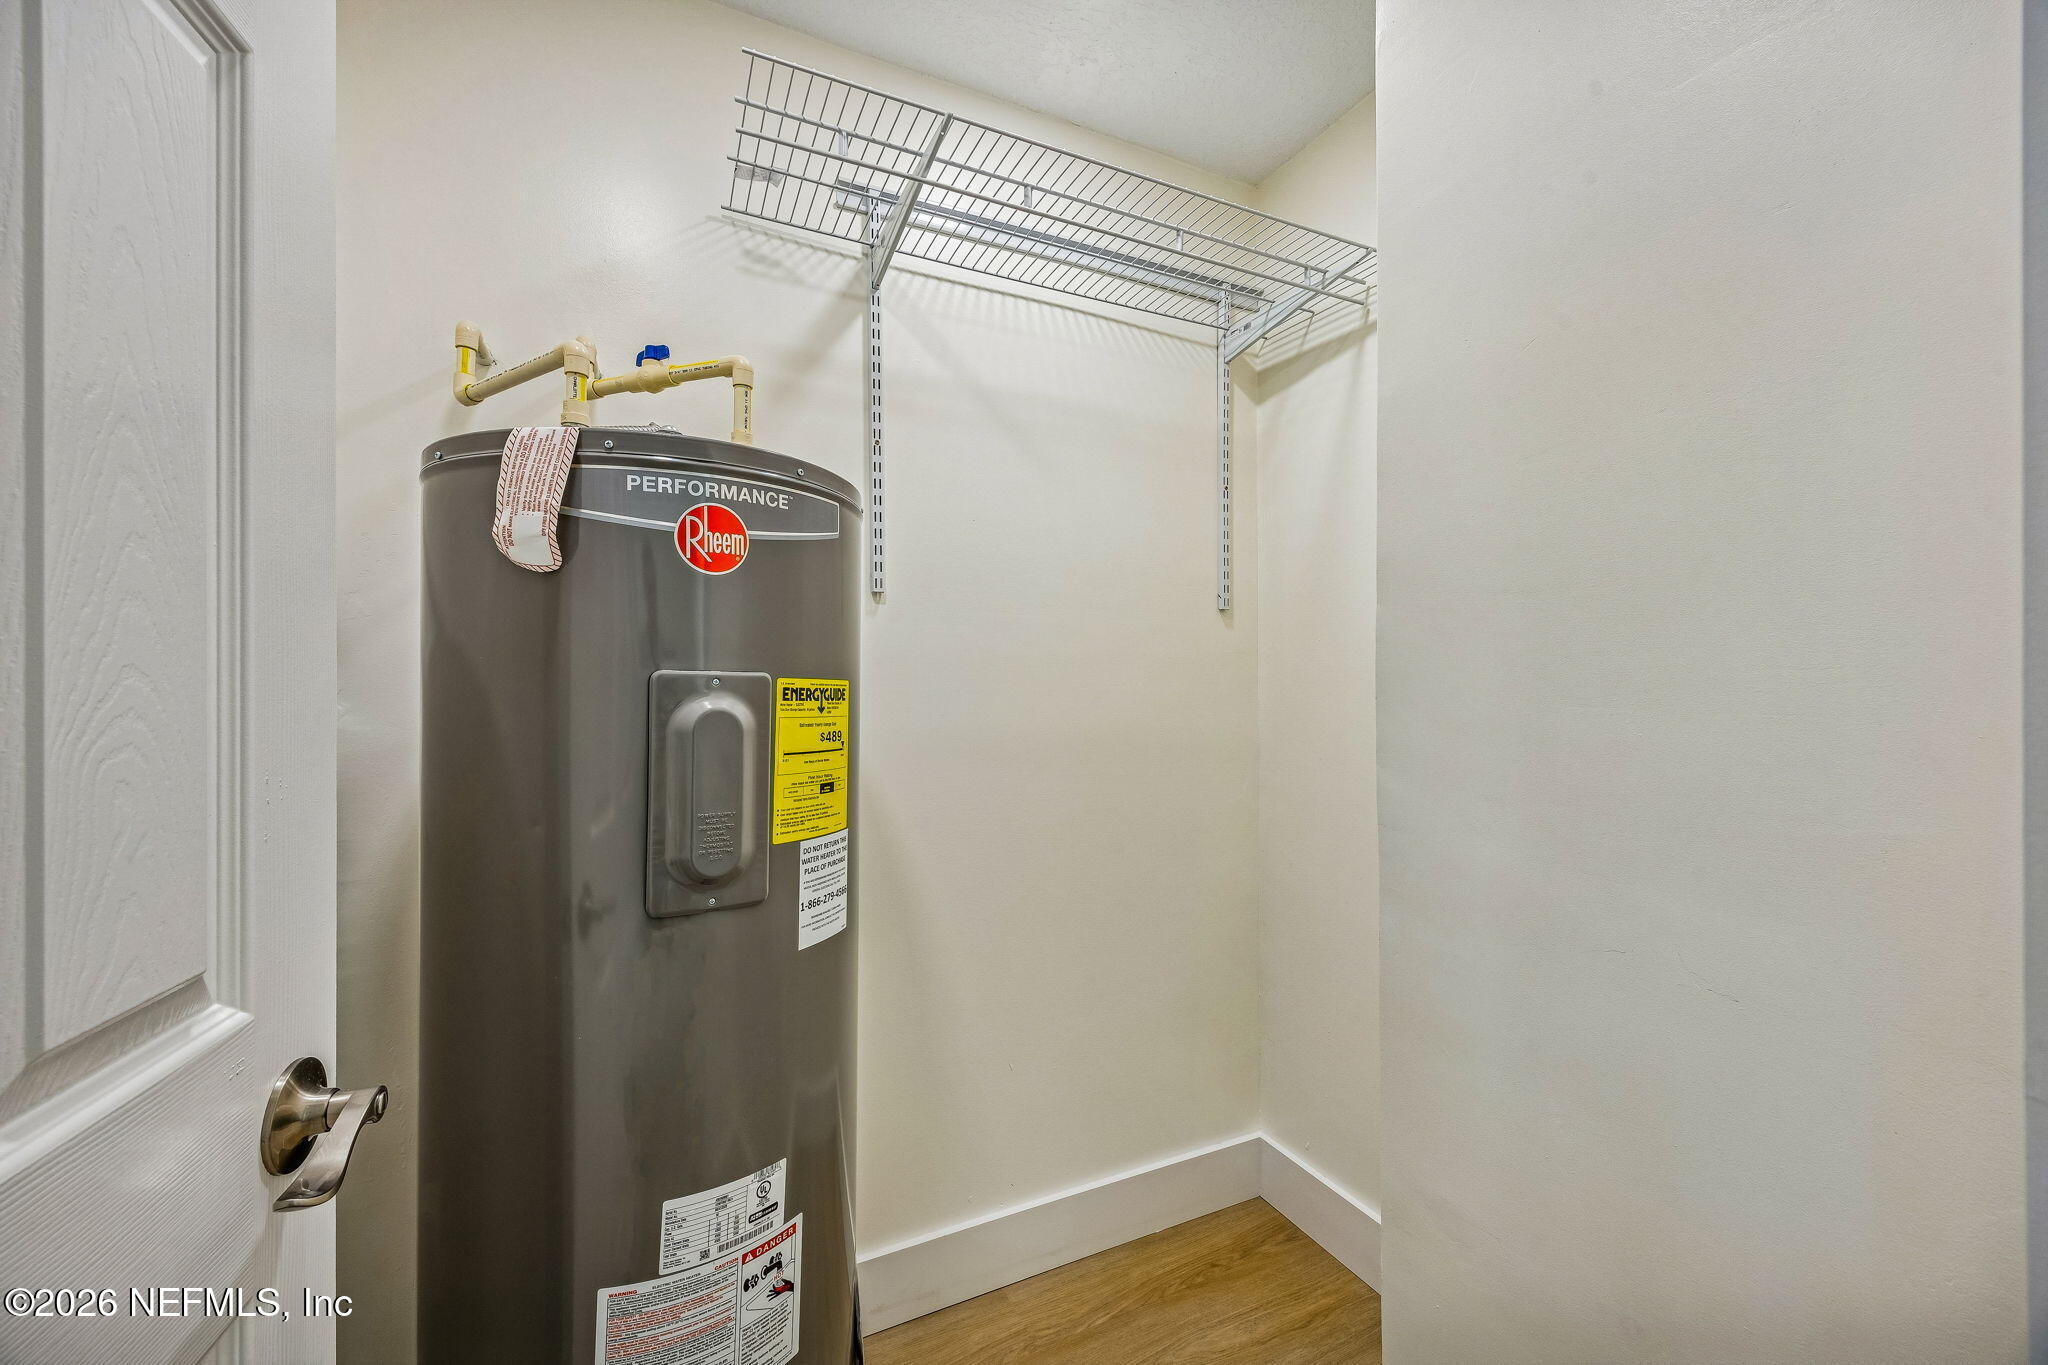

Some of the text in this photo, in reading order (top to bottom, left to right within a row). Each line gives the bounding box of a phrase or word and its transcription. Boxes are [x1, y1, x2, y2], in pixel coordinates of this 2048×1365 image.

[626, 474, 789, 510] PERFORMANCE
[685, 505, 745, 563] Rheem
[782, 687, 846, 701] ENERGYGUIDE
[820, 731, 842, 743] $489
[803, 847, 812, 855] DO
[812, 843, 823, 853] NOT
[801, 855, 820, 866] WATER
[820, 851, 836, 861] HEATER
[804, 864, 820, 876] PLACE
[820, 862, 827, 871] OF
[756, 1228, 794, 1256] DANGER
[714, 1257, 739, 1271] CAUTION
[608, 1289, 638, 1299] WARNING
